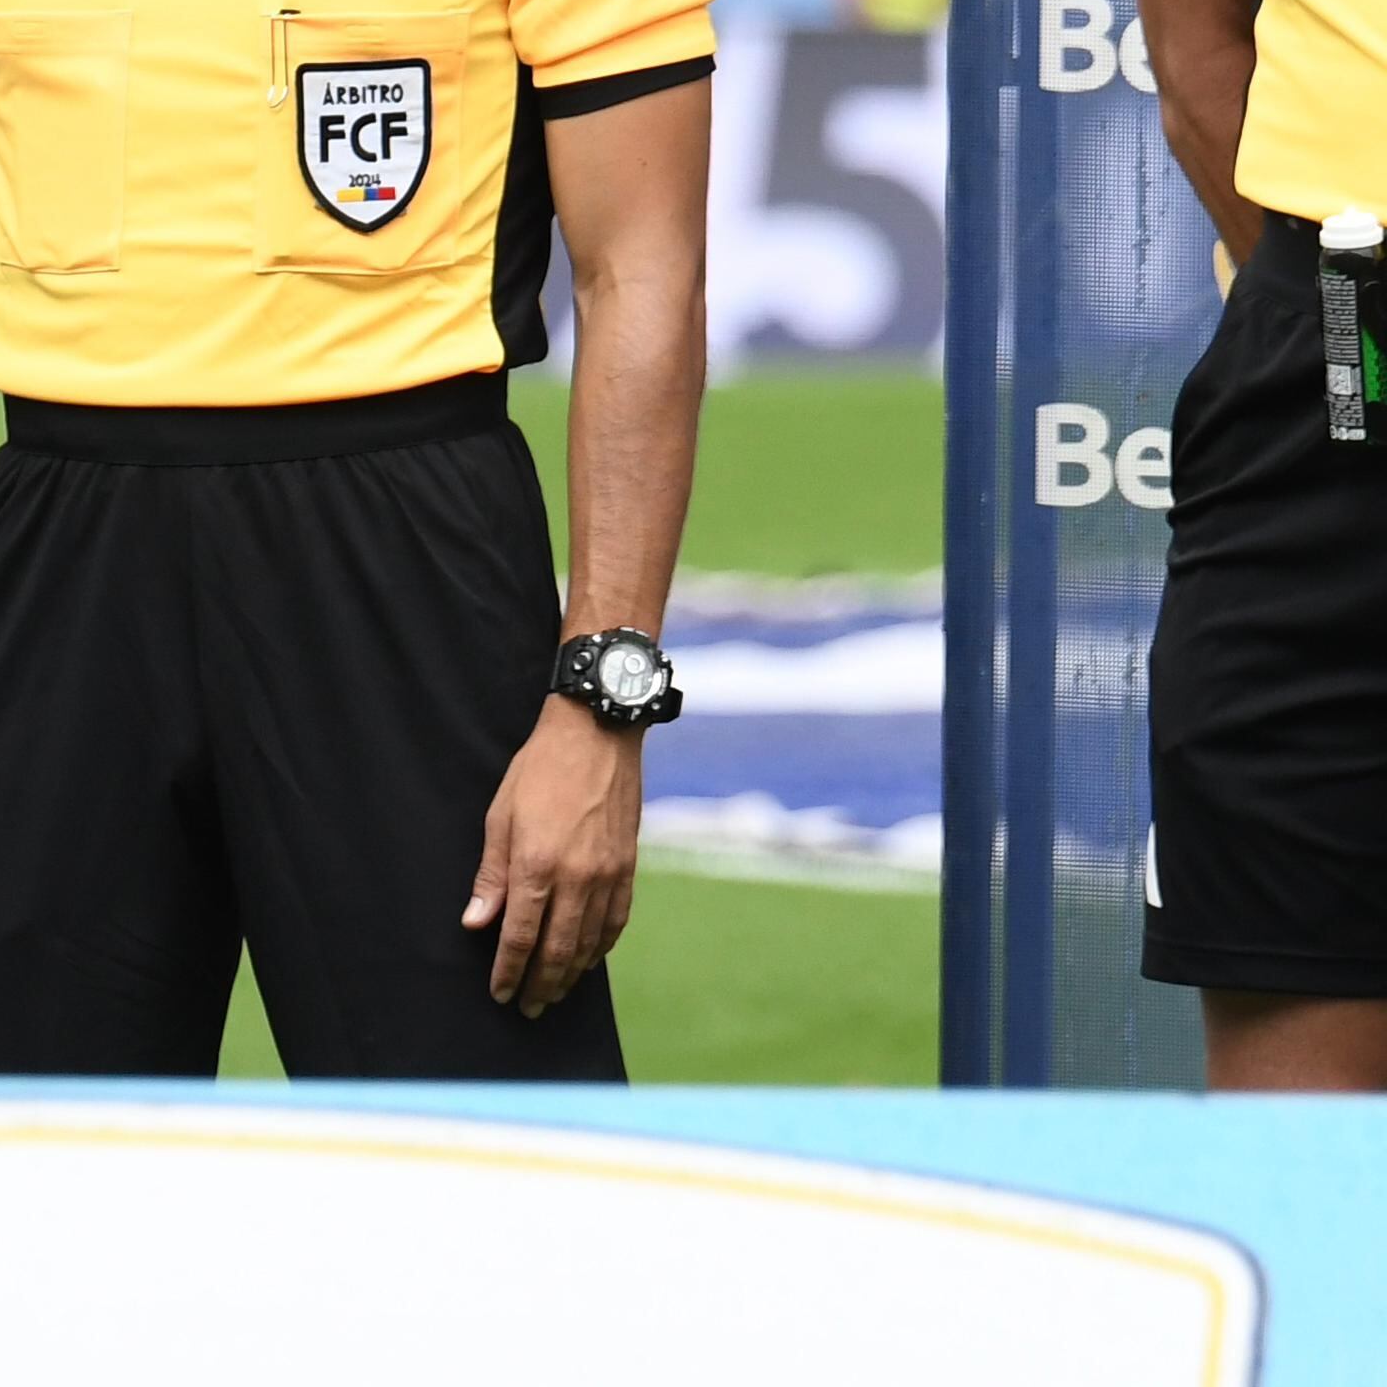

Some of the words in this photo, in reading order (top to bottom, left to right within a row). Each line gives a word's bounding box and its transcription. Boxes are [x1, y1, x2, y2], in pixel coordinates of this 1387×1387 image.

[322, 82, 404, 106] ÁRBITRO
[319, 111, 409, 164] FCF
[348, 174, 382, 188] 2024
[1035, 403, 1175, 509] Be
